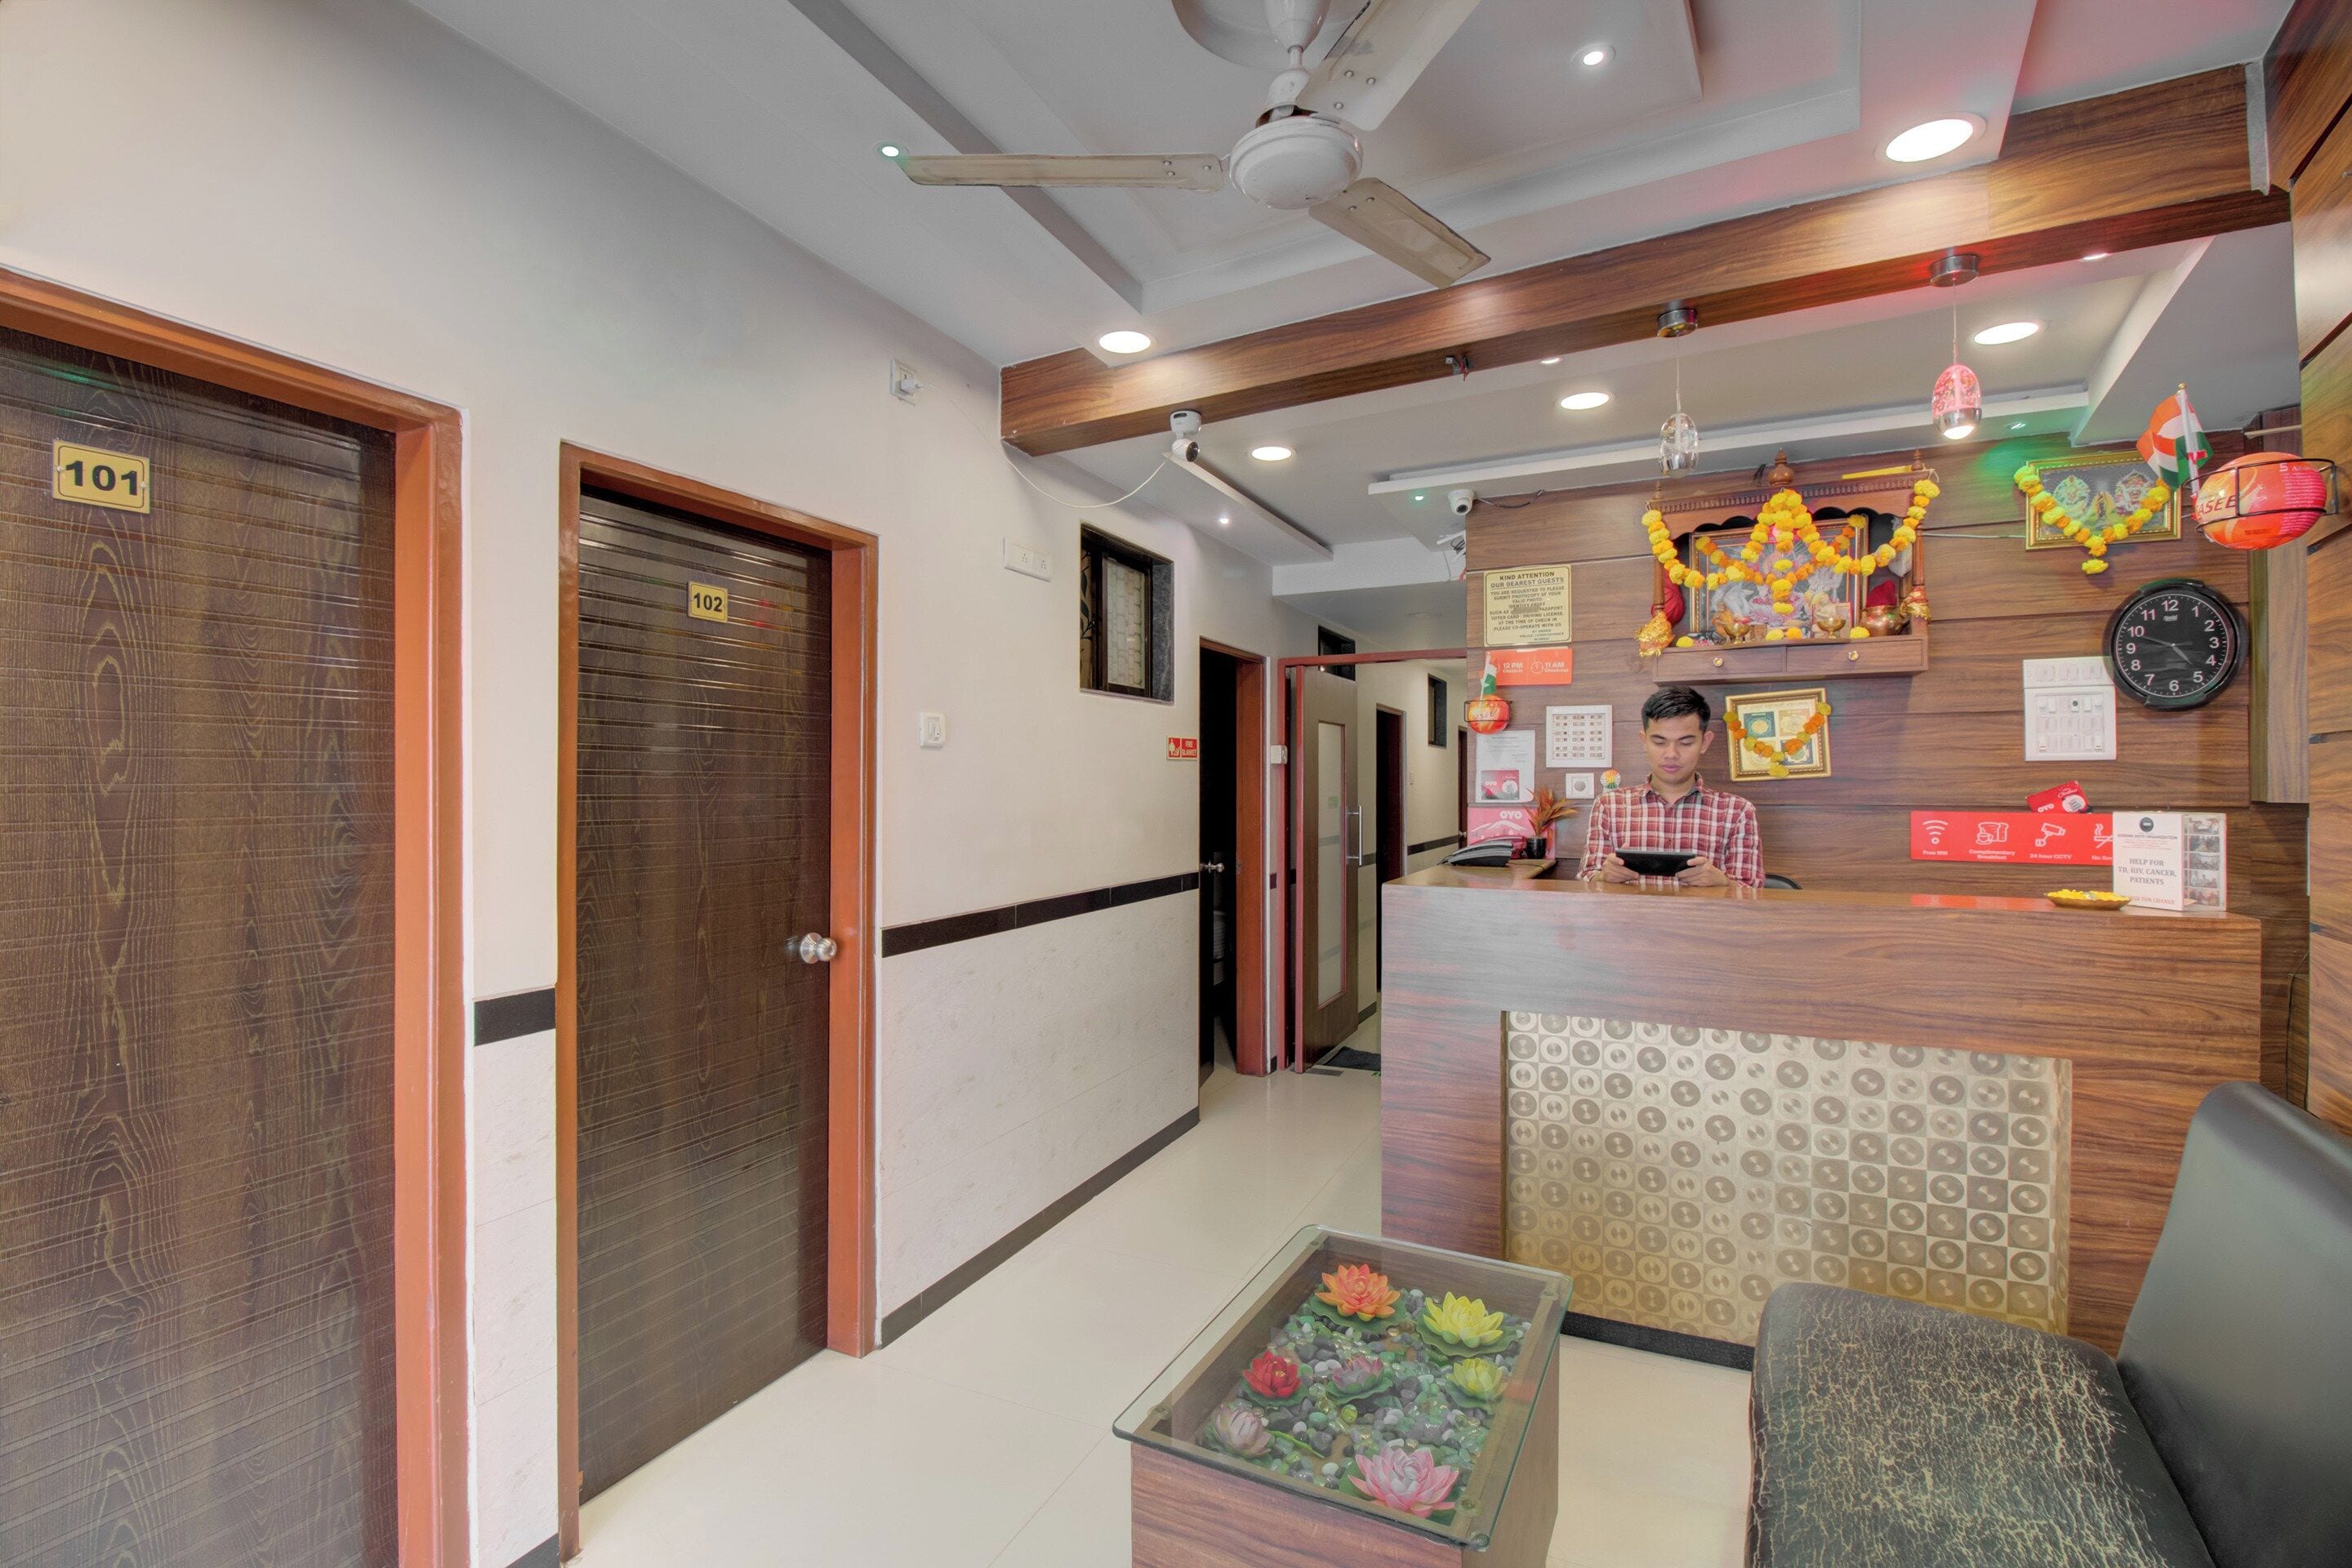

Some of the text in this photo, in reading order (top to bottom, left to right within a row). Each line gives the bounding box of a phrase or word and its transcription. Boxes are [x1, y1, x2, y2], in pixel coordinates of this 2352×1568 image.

[65, 460, 138, 497] 101
[693, 592, 723, 613] 102
[2161, 599, 2179, 612] 12
[2140, 609, 2156, 621] 11
[2191, 606, 2198, 617] 1
[2204, 620, 2215, 631] 2
[2127, 626, 2145, 637] 10
[2209, 637, 2220, 648] 3
[2126, 643, 2136, 654] 9
[2131, 659, 2140, 670] 8
[2206, 654, 2216, 666] 4
[2145, 674, 2155, 686] 7
[2193, 671, 2203, 683] 5
[2169, 680, 2179, 692] 6
[2037, 803, 2055, 813] OYO
[1499, 810, 1522, 819] OYO
[2129, 858, 2149, 866] HELP
[2130, 876, 2164, 884] PATIENTS
